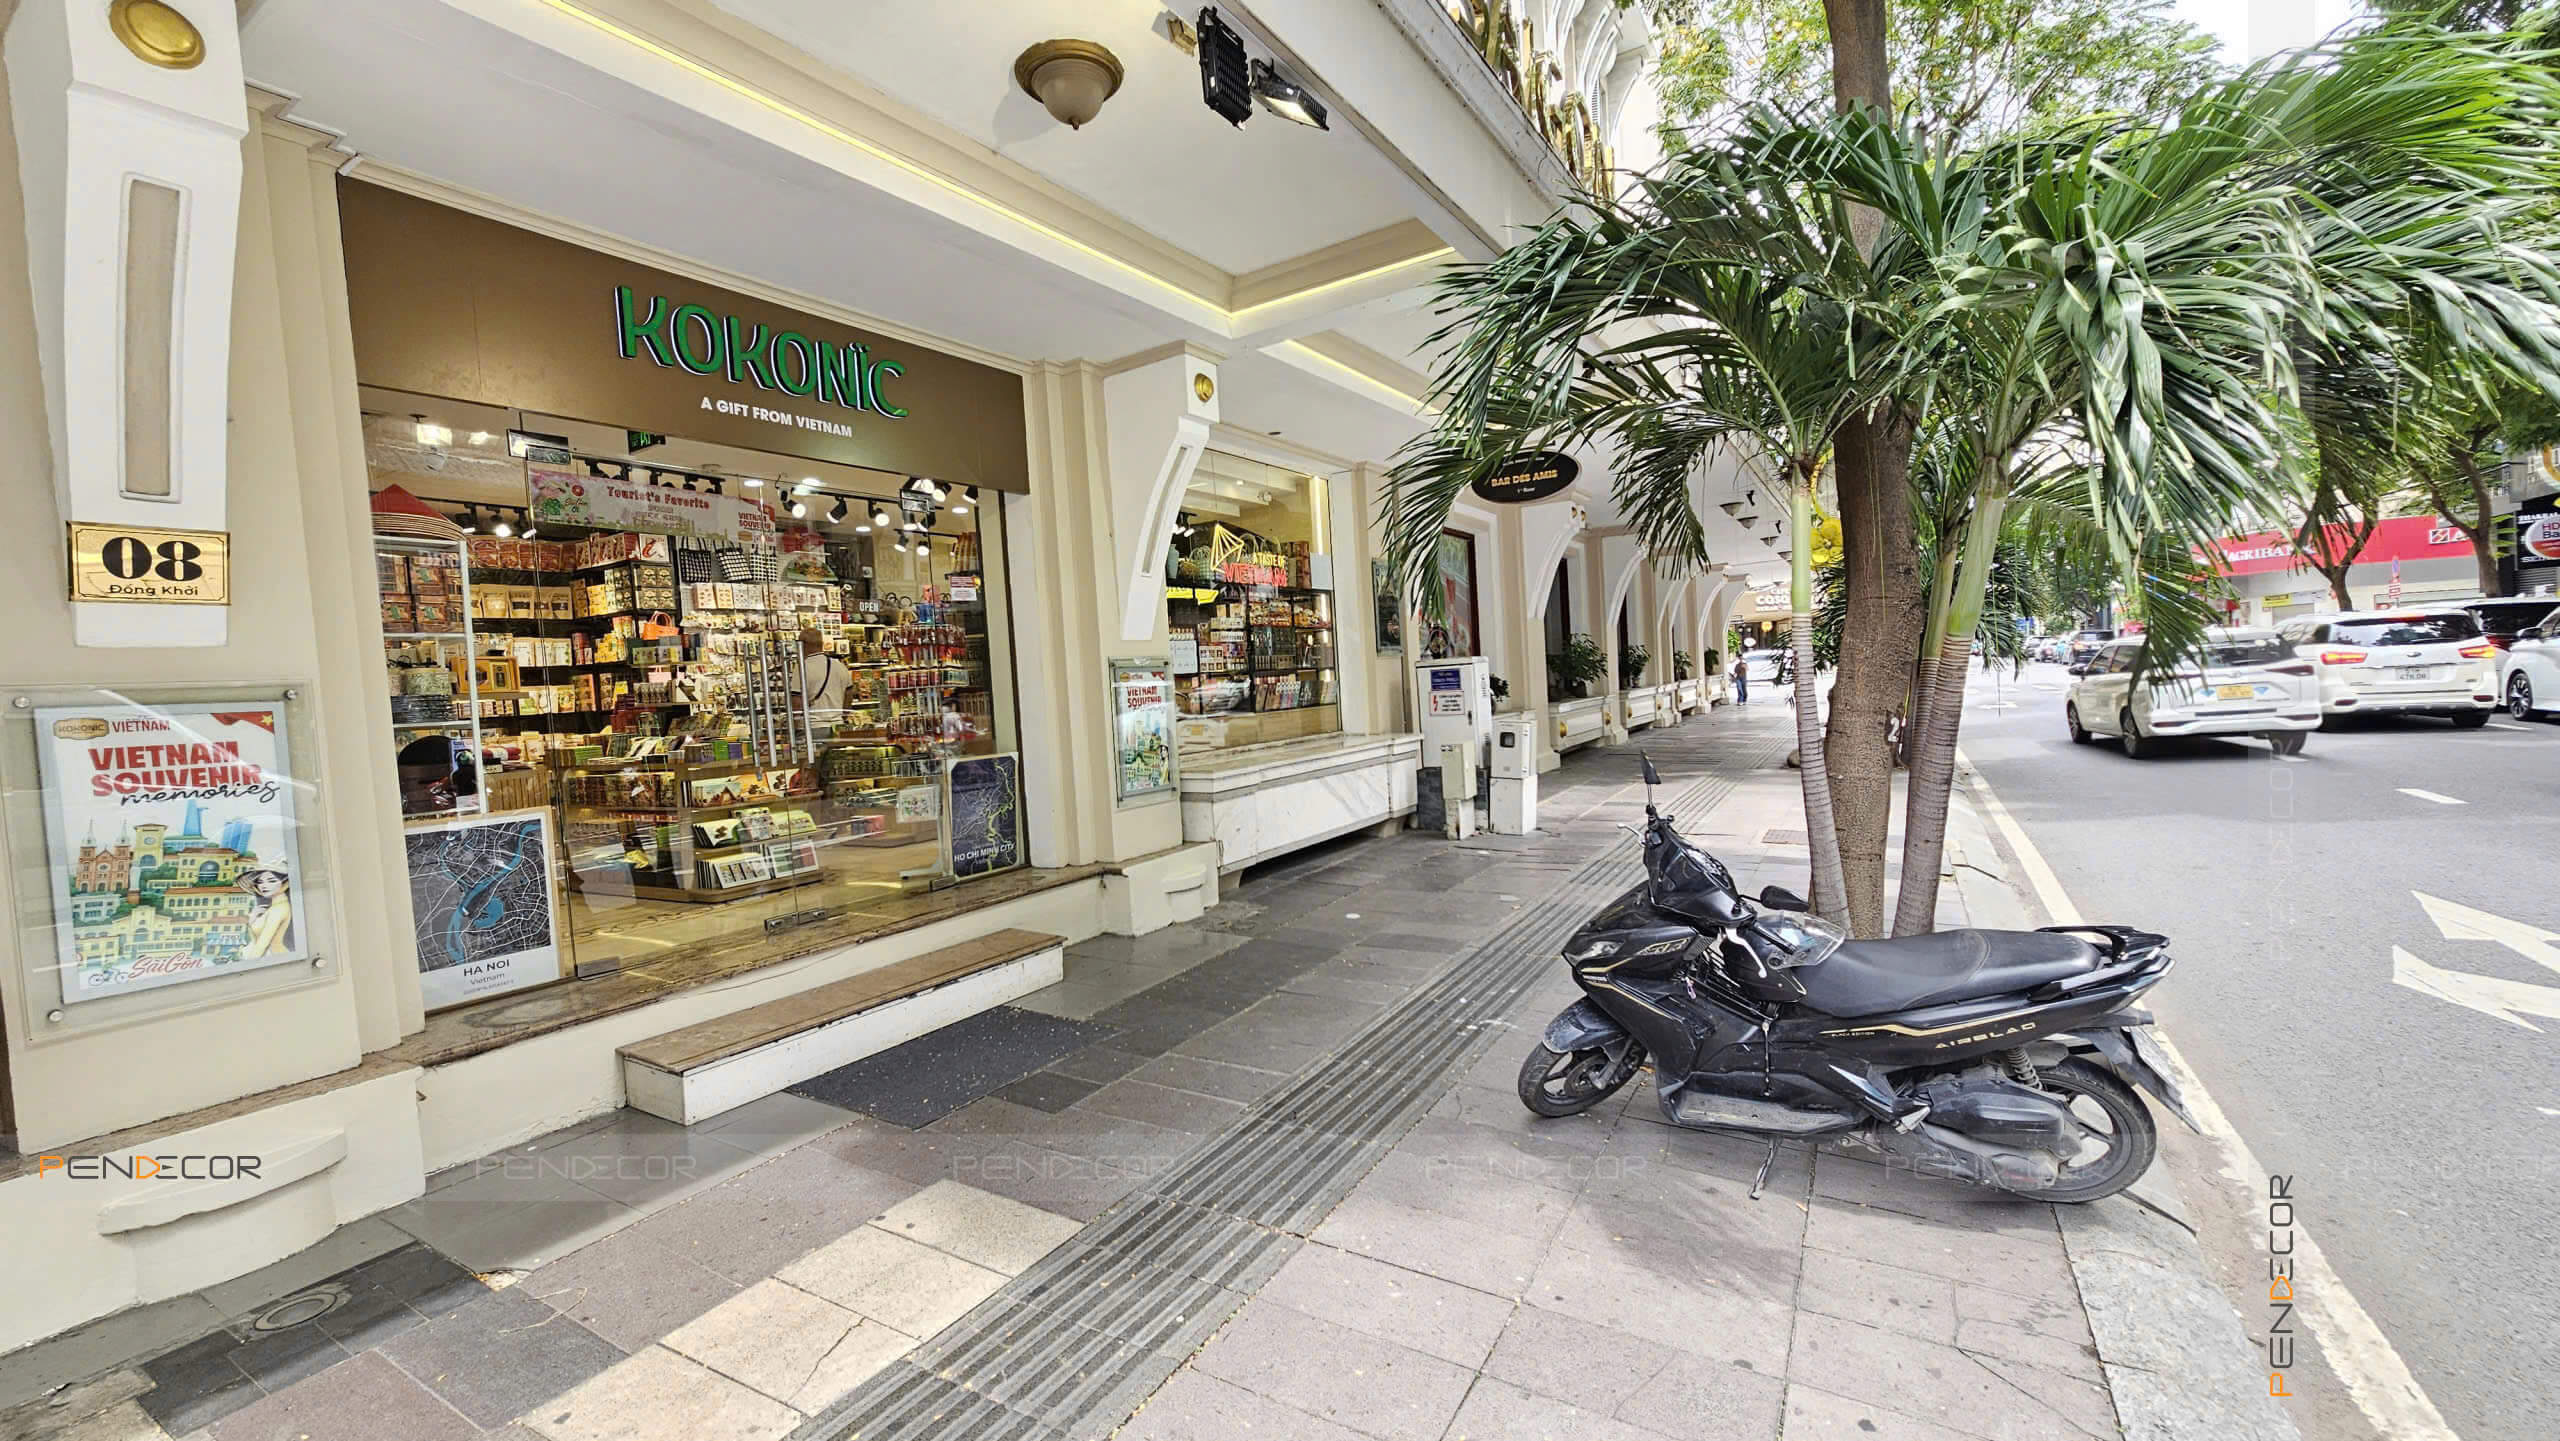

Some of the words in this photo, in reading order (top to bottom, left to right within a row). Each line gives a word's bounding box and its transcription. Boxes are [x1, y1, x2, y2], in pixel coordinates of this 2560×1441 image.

[701, 397, 712, 411] A
[716, 400, 749, 417] GIFT
[752, 407, 793, 426] FROM
[795, 415, 853, 438] VIETNAM
[1491, 477, 1511, 488] BAR
[664, 493, 710, 510] Favorite
[102, 536, 203, 582] 08
[859, 601, 880, 613] OPEN
[1127, 685, 1158, 697] VIETNAM
[1127, 695, 1162, 709] SOUVENIR
[112, 719, 170, 733] VIETNAM
[88, 741, 240, 771] VIETNAM
[91, 764, 263, 797] SOUVENIR
[120, 780, 281, 807] memories
[463, 967, 482, 977] HA
[486, 959, 510, 972] NOI
